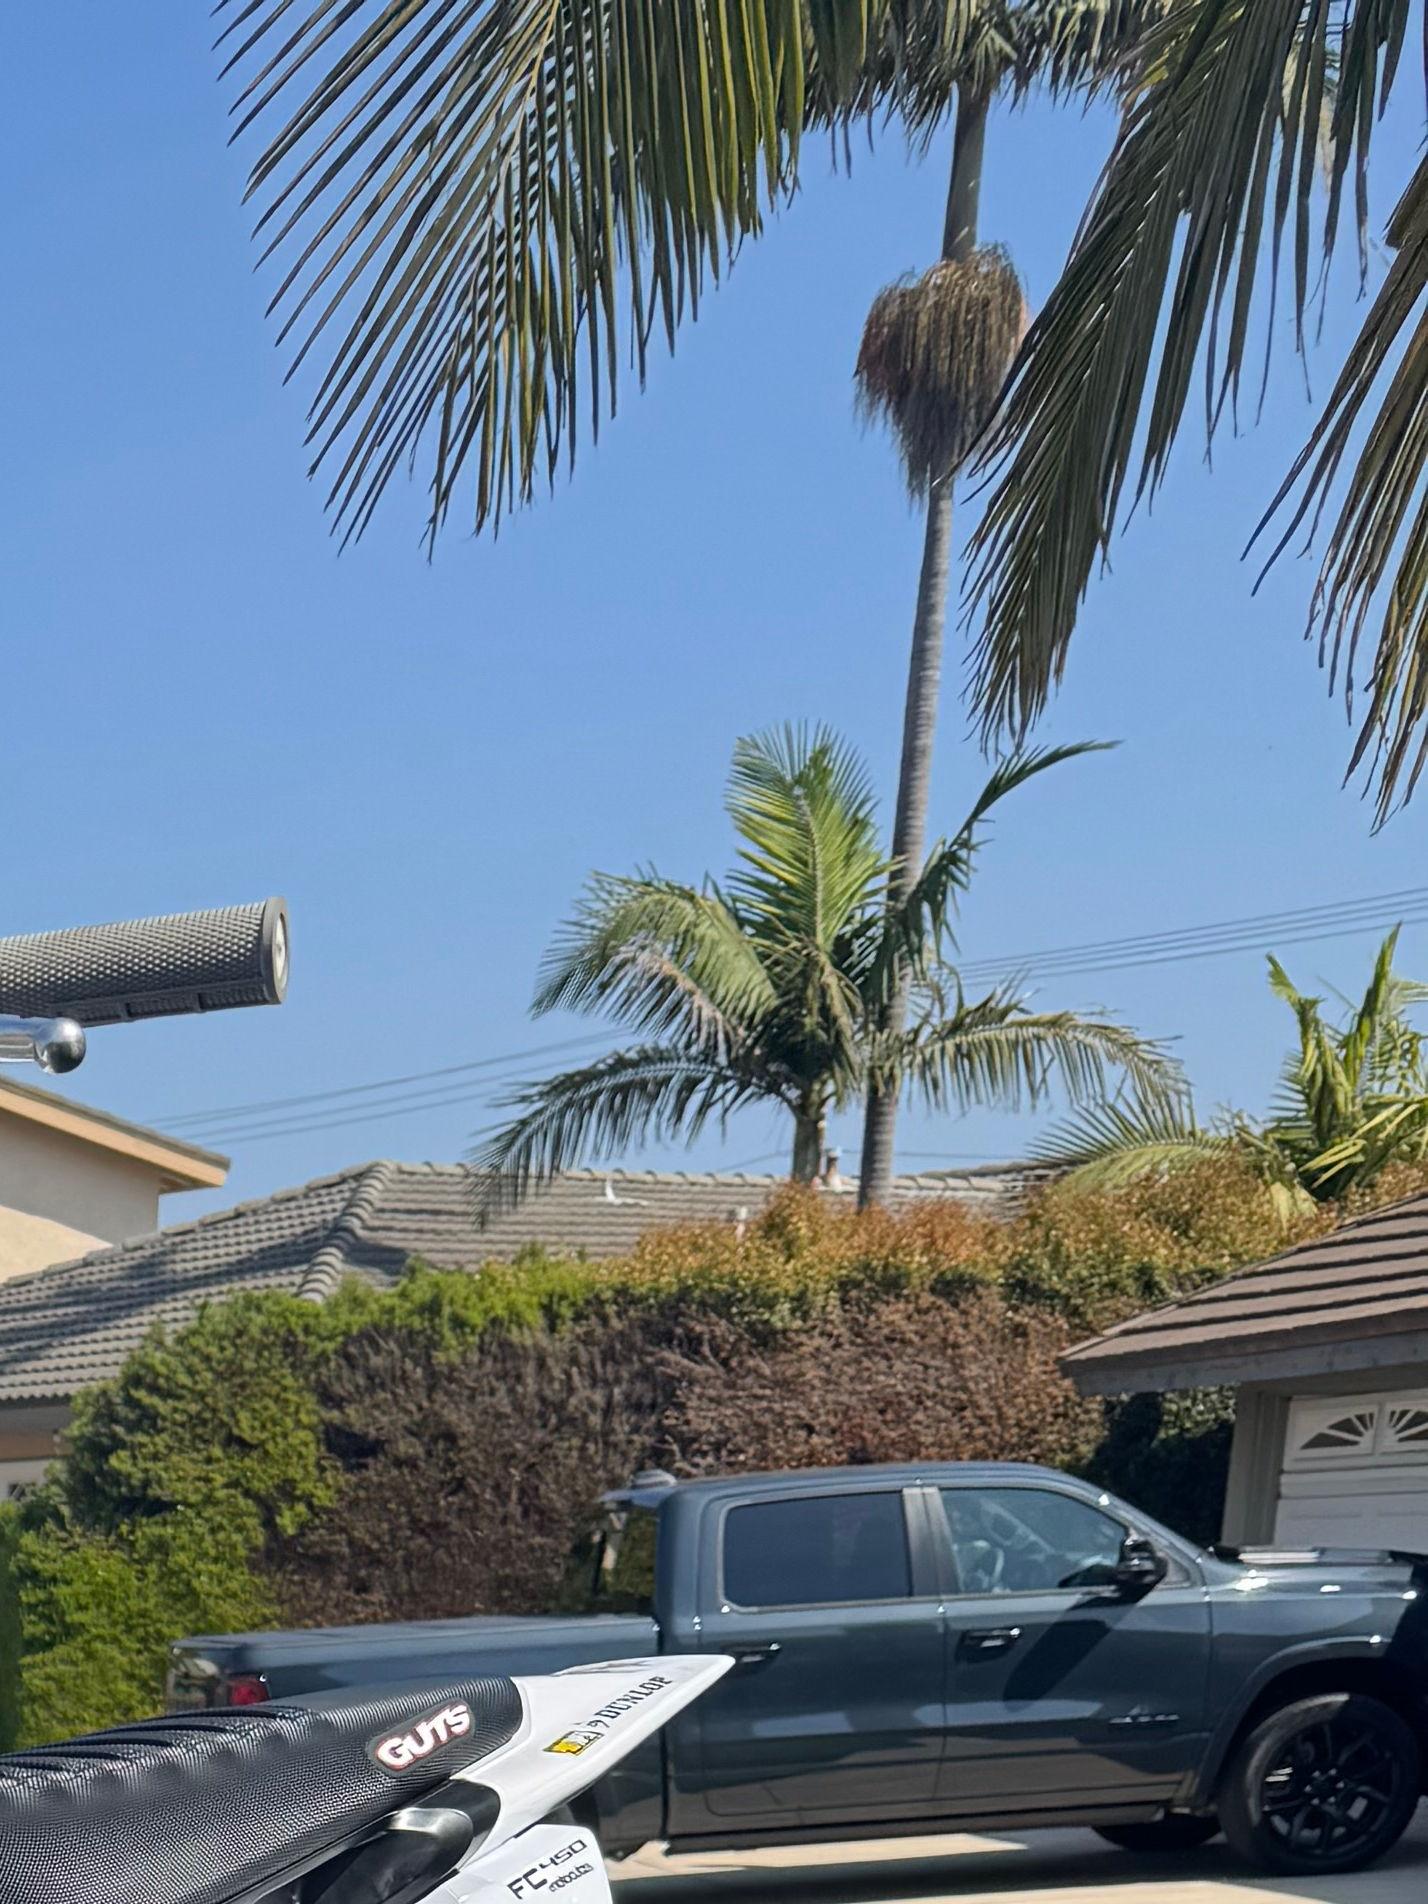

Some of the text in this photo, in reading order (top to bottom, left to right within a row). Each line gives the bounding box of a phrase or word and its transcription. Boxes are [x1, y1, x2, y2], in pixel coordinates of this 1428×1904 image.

[596, 1675, 673, 1719] DUNLOP
[375, 1703, 472, 1771] GUTS
[507, 1839, 588, 1900] FC 450
